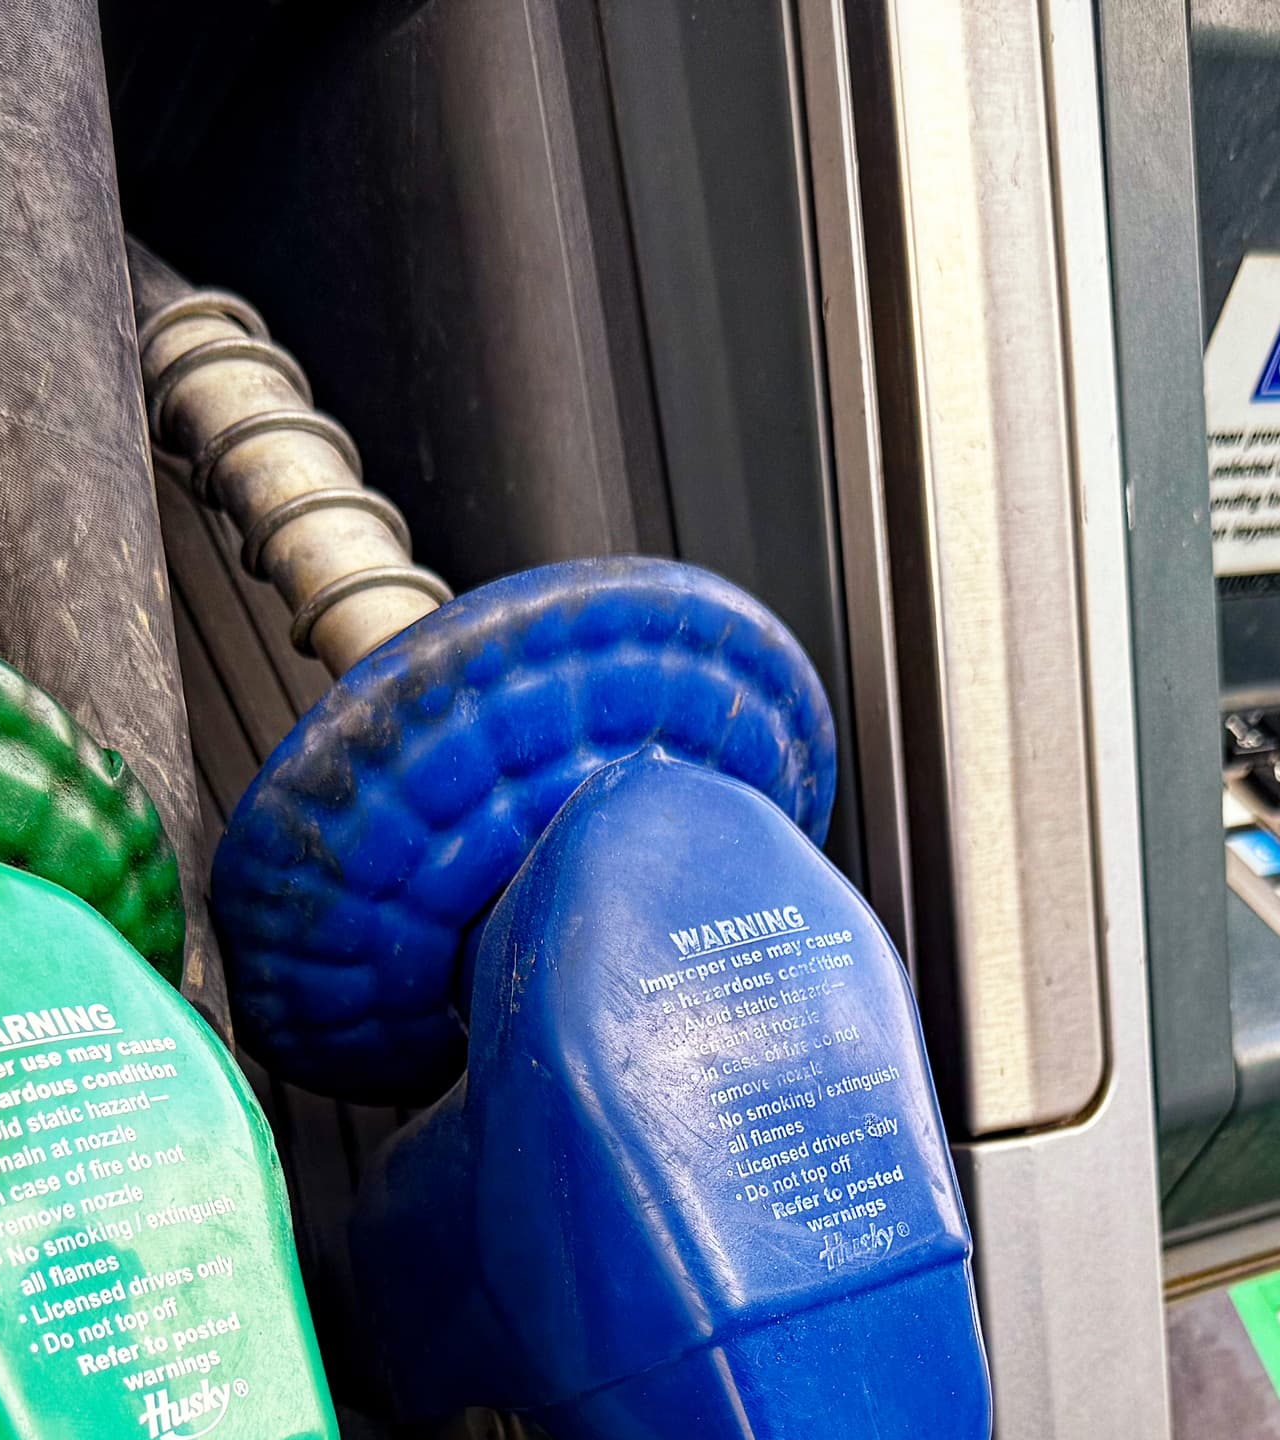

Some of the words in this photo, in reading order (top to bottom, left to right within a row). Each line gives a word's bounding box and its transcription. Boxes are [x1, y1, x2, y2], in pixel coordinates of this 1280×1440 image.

[670, 905, 809, 958] WARNING
[639, 957, 728, 994] Improper
[730, 948, 763, 968] use
[767, 940, 802, 960] may
[805, 929, 853, 950] cause
[662, 999, 676, 1015] a
[677, 971, 774, 1010] hazardous
[683, 1006, 733, 1035] Avoid
[735, 995, 779, 1019] static
[752, 1022, 770, 1041] at
[772, 1010, 820, 1036] nozzle
[21, 1049, 62, 1072] use
[68, 1040, 113, 1064] may
[117, 1034, 177, 1056] cause
[82, 1061, 177, 1090] condition
[700, 1064, 719, 1083] In
[722, 1053, 759, 1076] case
[764, 1045, 782, 1063] of
[782, 1038, 809, 1057] fire
[814, 1032, 833, 1049] do
[835, 1023, 860, 1044] not
[709, 1079, 770, 1107] remove
[717, 1111, 743, 1131] No
[746, 1090, 815, 1121] smoking
[825, 1065, 900, 1098] extinguish
[27, 1101, 84, 1133] static
[727, 1136, 748, 1154] all
[750, 1119, 805, 1148] flames
[50, 1136, 72, 1159] at
[76, 1125, 137, 1153] nozzle
[736, 1142, 810, 1178] Licensed
[812, 1126, 865, 1155] drivers
[868, 1115, 899, 1138] only
[10, 1175, 61, 1202] case
[65, 1165, 88, 1186] of
[89, 1157, 124, 1180] fire
[127, 1150, 152, 1172] do
[155, 1144, 187, 1165] not
[745, 1182, 769, 1202] Do
[772, 1172, 800, 1194] not
[801, 1163, 828, 1186] top
[830, 1154, 852, 1175] off
[771, 1192, 820, 1220] Refer
[823, 1186, 843, 1205] to
[846, 1164, 905, 1197] posted
[81, 1183, 144, 1213] nozzle
[806, 1196, 887, 1233] warnings
[7, 1244, 40, 1268] No
[43, 1218, 133, 1258] smoking
[146, 1194, 237, 1229] extinguish
[20, 1271, 47, 1297] all
[49, 1252, 120, 1287] flames
[30, 1280, 126, 1325] Licensed
[129, 1265, 194, 1297] drivers
[197, 1254, 235, 1278] only
[42, 1331, 74, 1355] Do
[78, 1316, 114, 1344] not
[115, 1308, 149, 1333] top
[152, 1297, 179, 1321] off
[77, 1342, 140, 1376] Refer
[143, 1333, 168, 1355] to
[172, 1311, 241, 1350] posted
[123, 1349, 221, 1391] warnings
